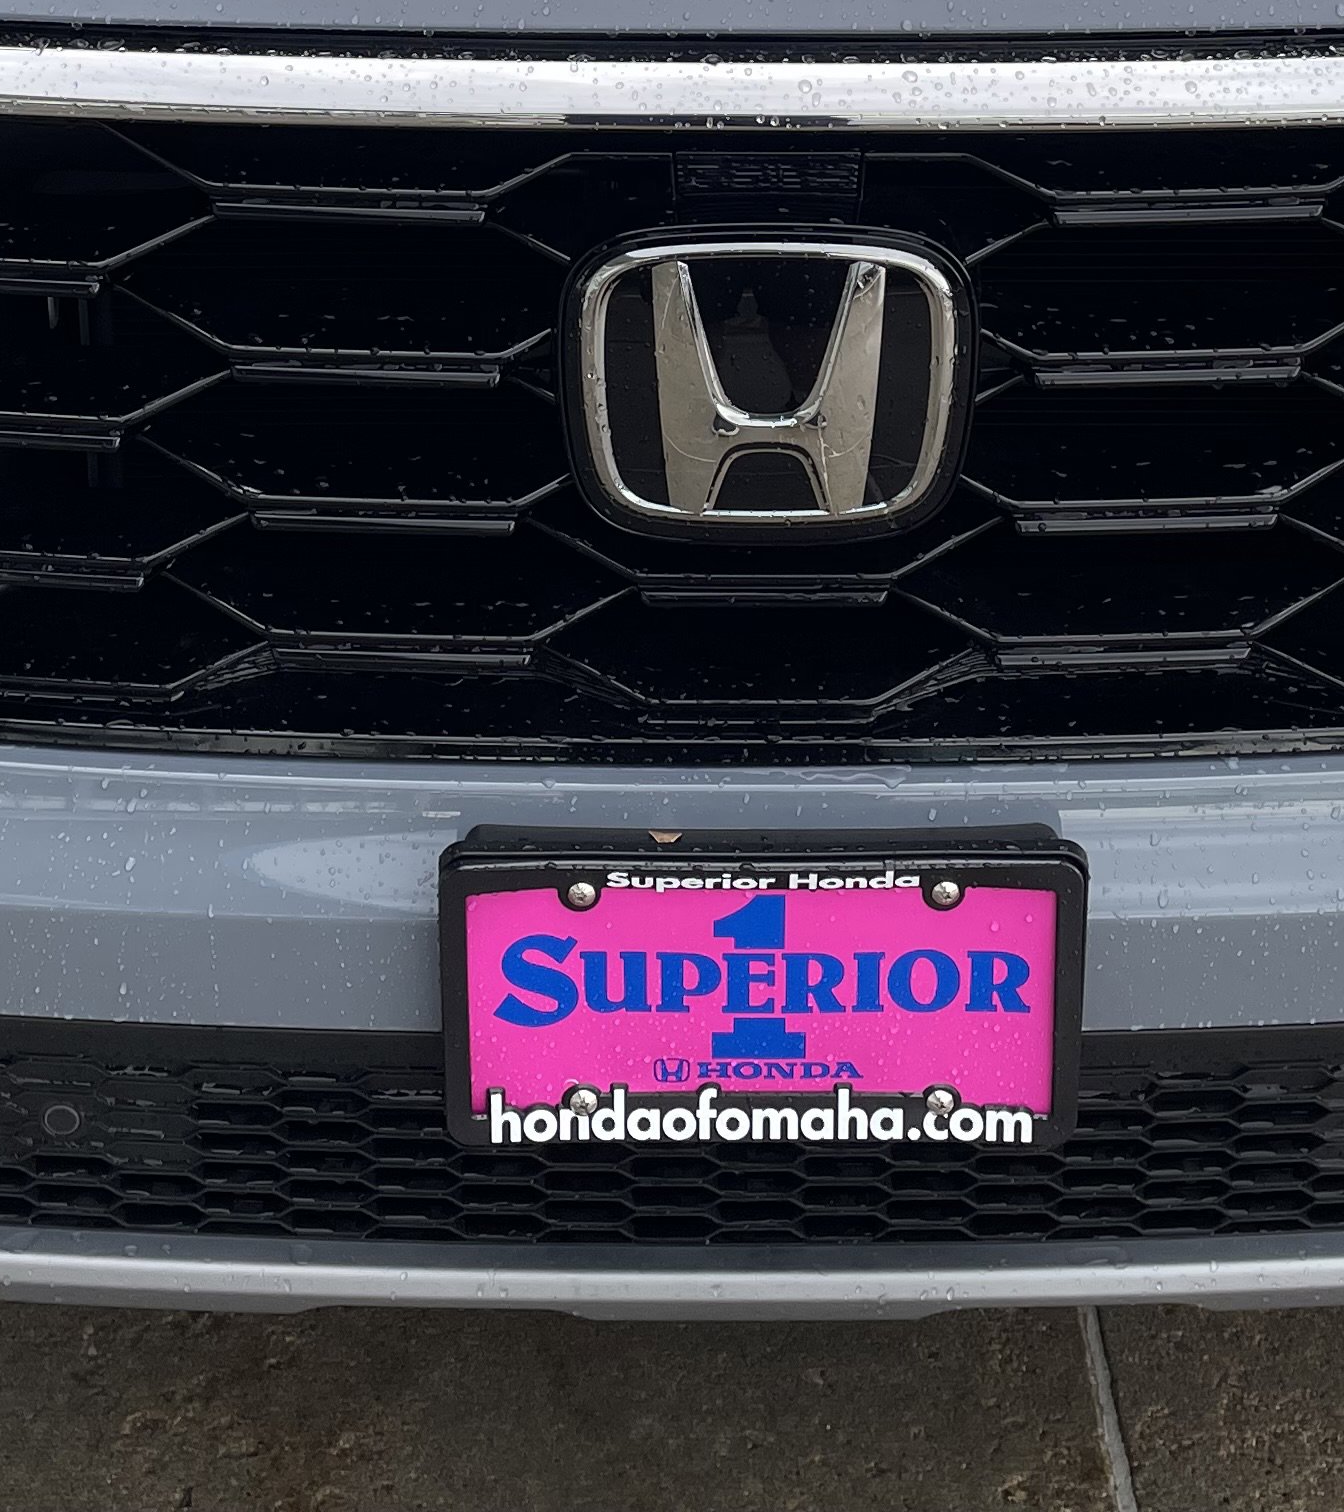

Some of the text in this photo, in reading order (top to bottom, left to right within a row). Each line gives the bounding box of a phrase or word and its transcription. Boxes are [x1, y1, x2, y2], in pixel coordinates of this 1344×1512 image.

[606, 870, 922, 892] Superior Honda
[493, 933, 1031, 1028] SUPERIOR
[697, 1061, 864, 1080] HONDA
[489, 1089, 1033, 1144] hondaofomaha.com
